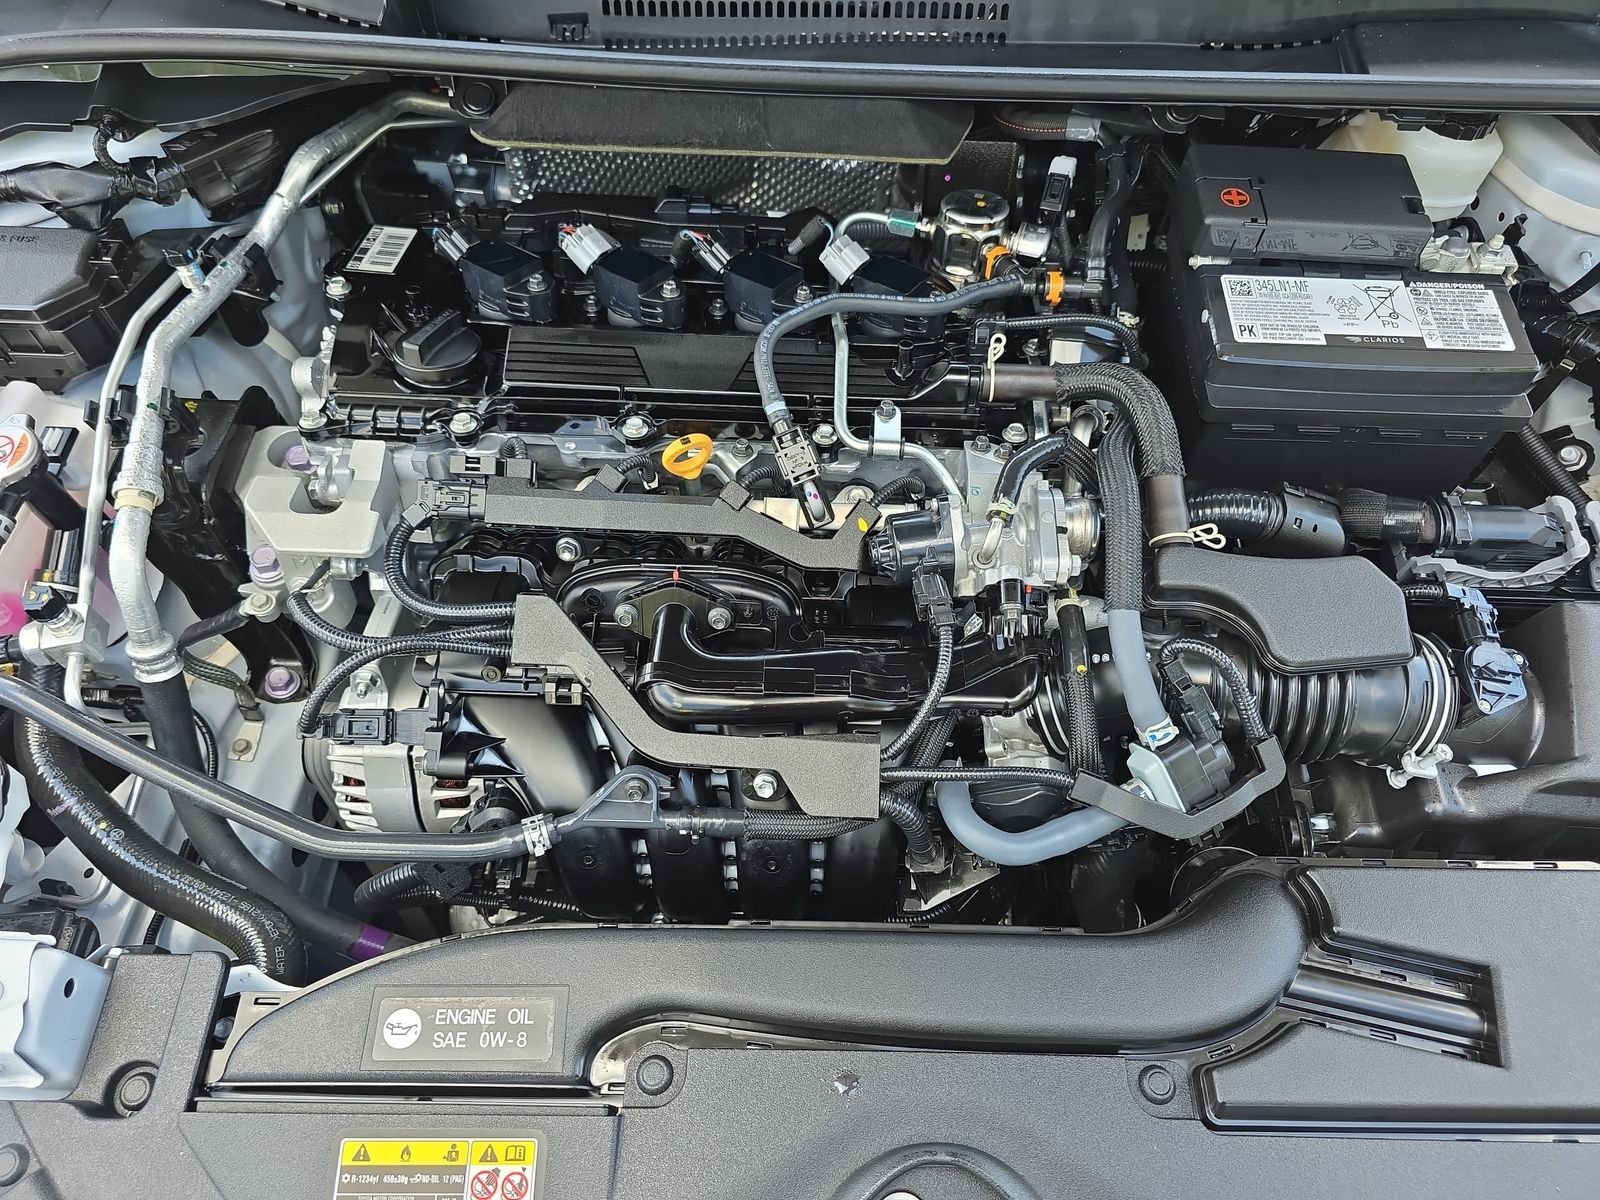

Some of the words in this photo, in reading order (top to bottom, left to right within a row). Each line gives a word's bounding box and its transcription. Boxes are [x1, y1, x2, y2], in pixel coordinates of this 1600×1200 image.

[1255, 280, 1309, 292] 345LN1-MF
[1239, 324, 1257, 337] PK
[1382, 320, 1399, 328] Pb
[274, 945, 284, 975] WATER
[434, 1008, 496, 1024] ENGINE
[508, 1008, 534, 1024] OIL
[432, 1032, 468, 1048] SAE
[480, 1032, 528, 1048] 0W-8
[351, 1174, 380, 1184] R-1234yf
[443, 1175, 449, 1183] 12
